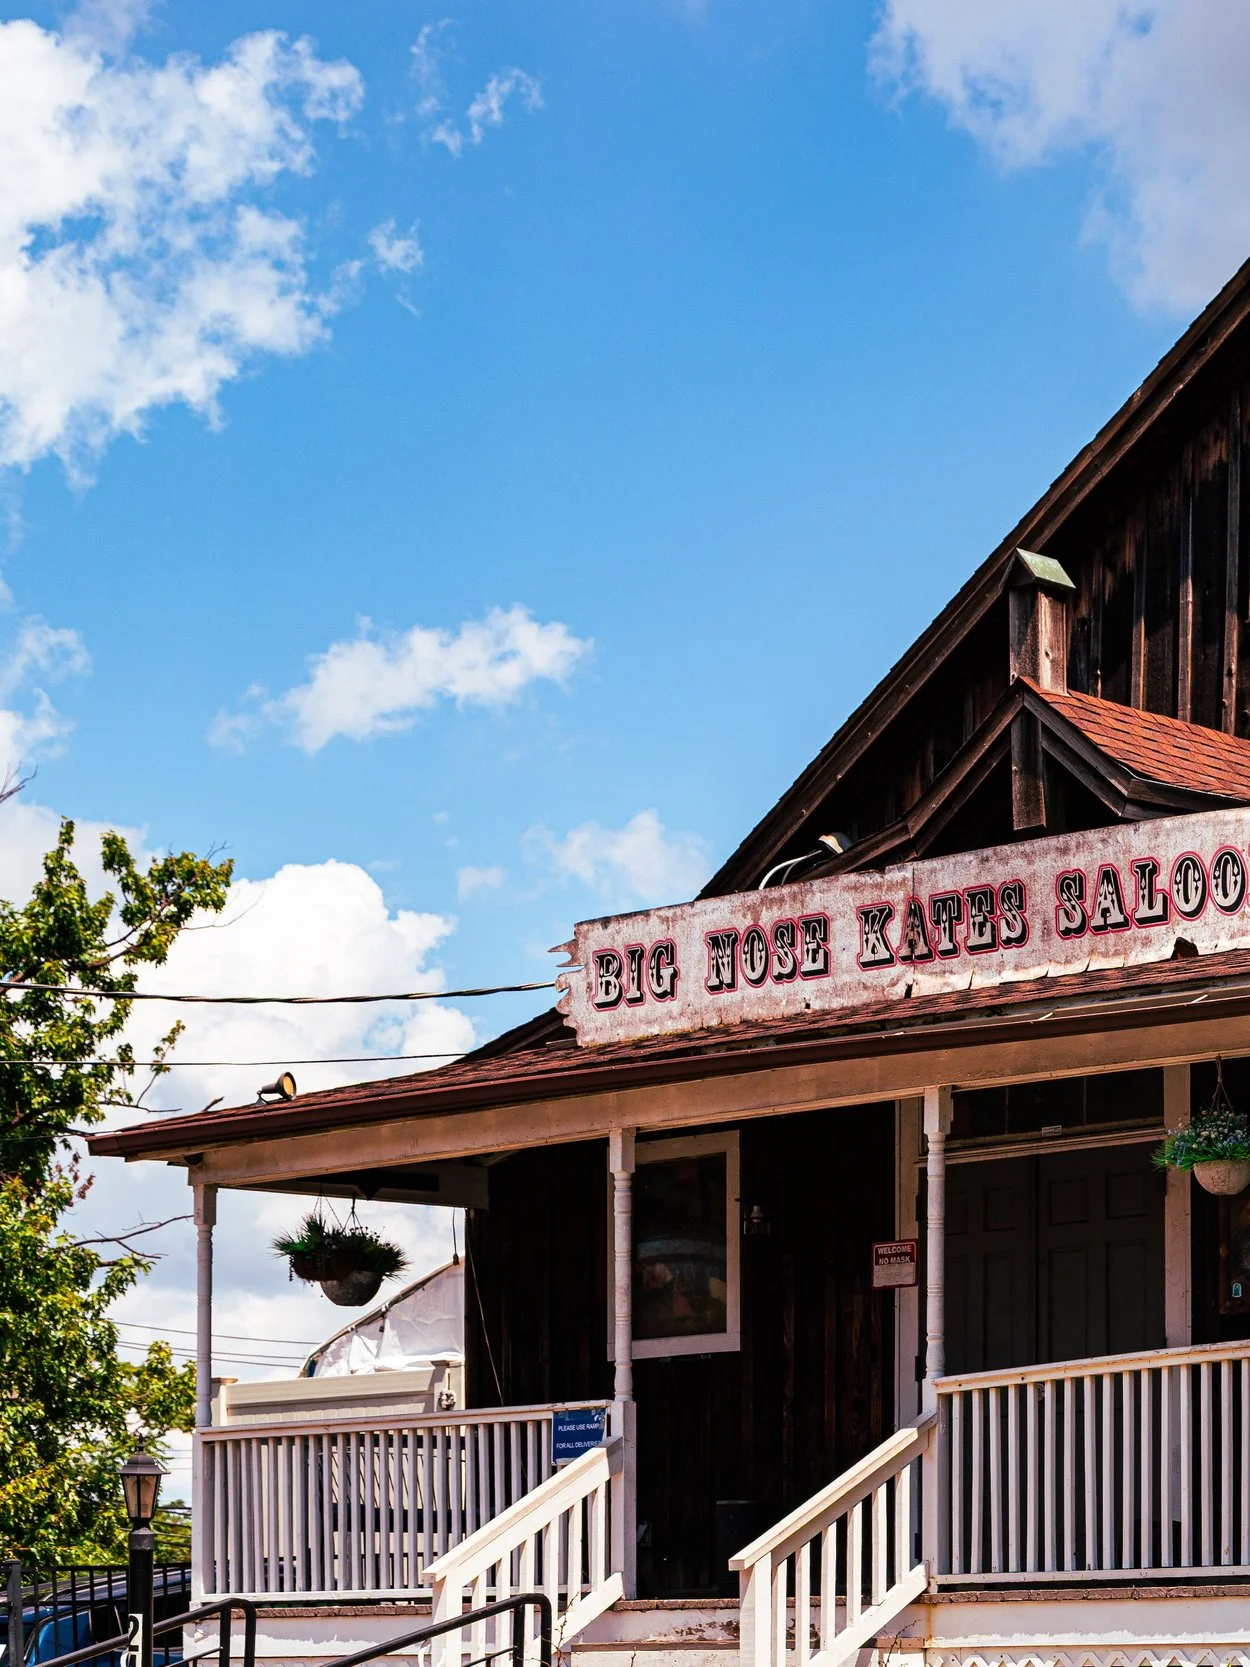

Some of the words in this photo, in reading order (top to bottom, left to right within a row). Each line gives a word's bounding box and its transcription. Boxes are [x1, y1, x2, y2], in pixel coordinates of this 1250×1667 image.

[592, 938, 680, 1012] BIG
[704, 912, 831, 995] NOSE
[856, 880, 1029, 971] KATES
[877, 1245, 912, 1255] WELCOME
[879, 1257, 889, 1265] NO
[890, 1255, 911, 1264] MASK
[586, 1422, 600, 1430] RAMP
